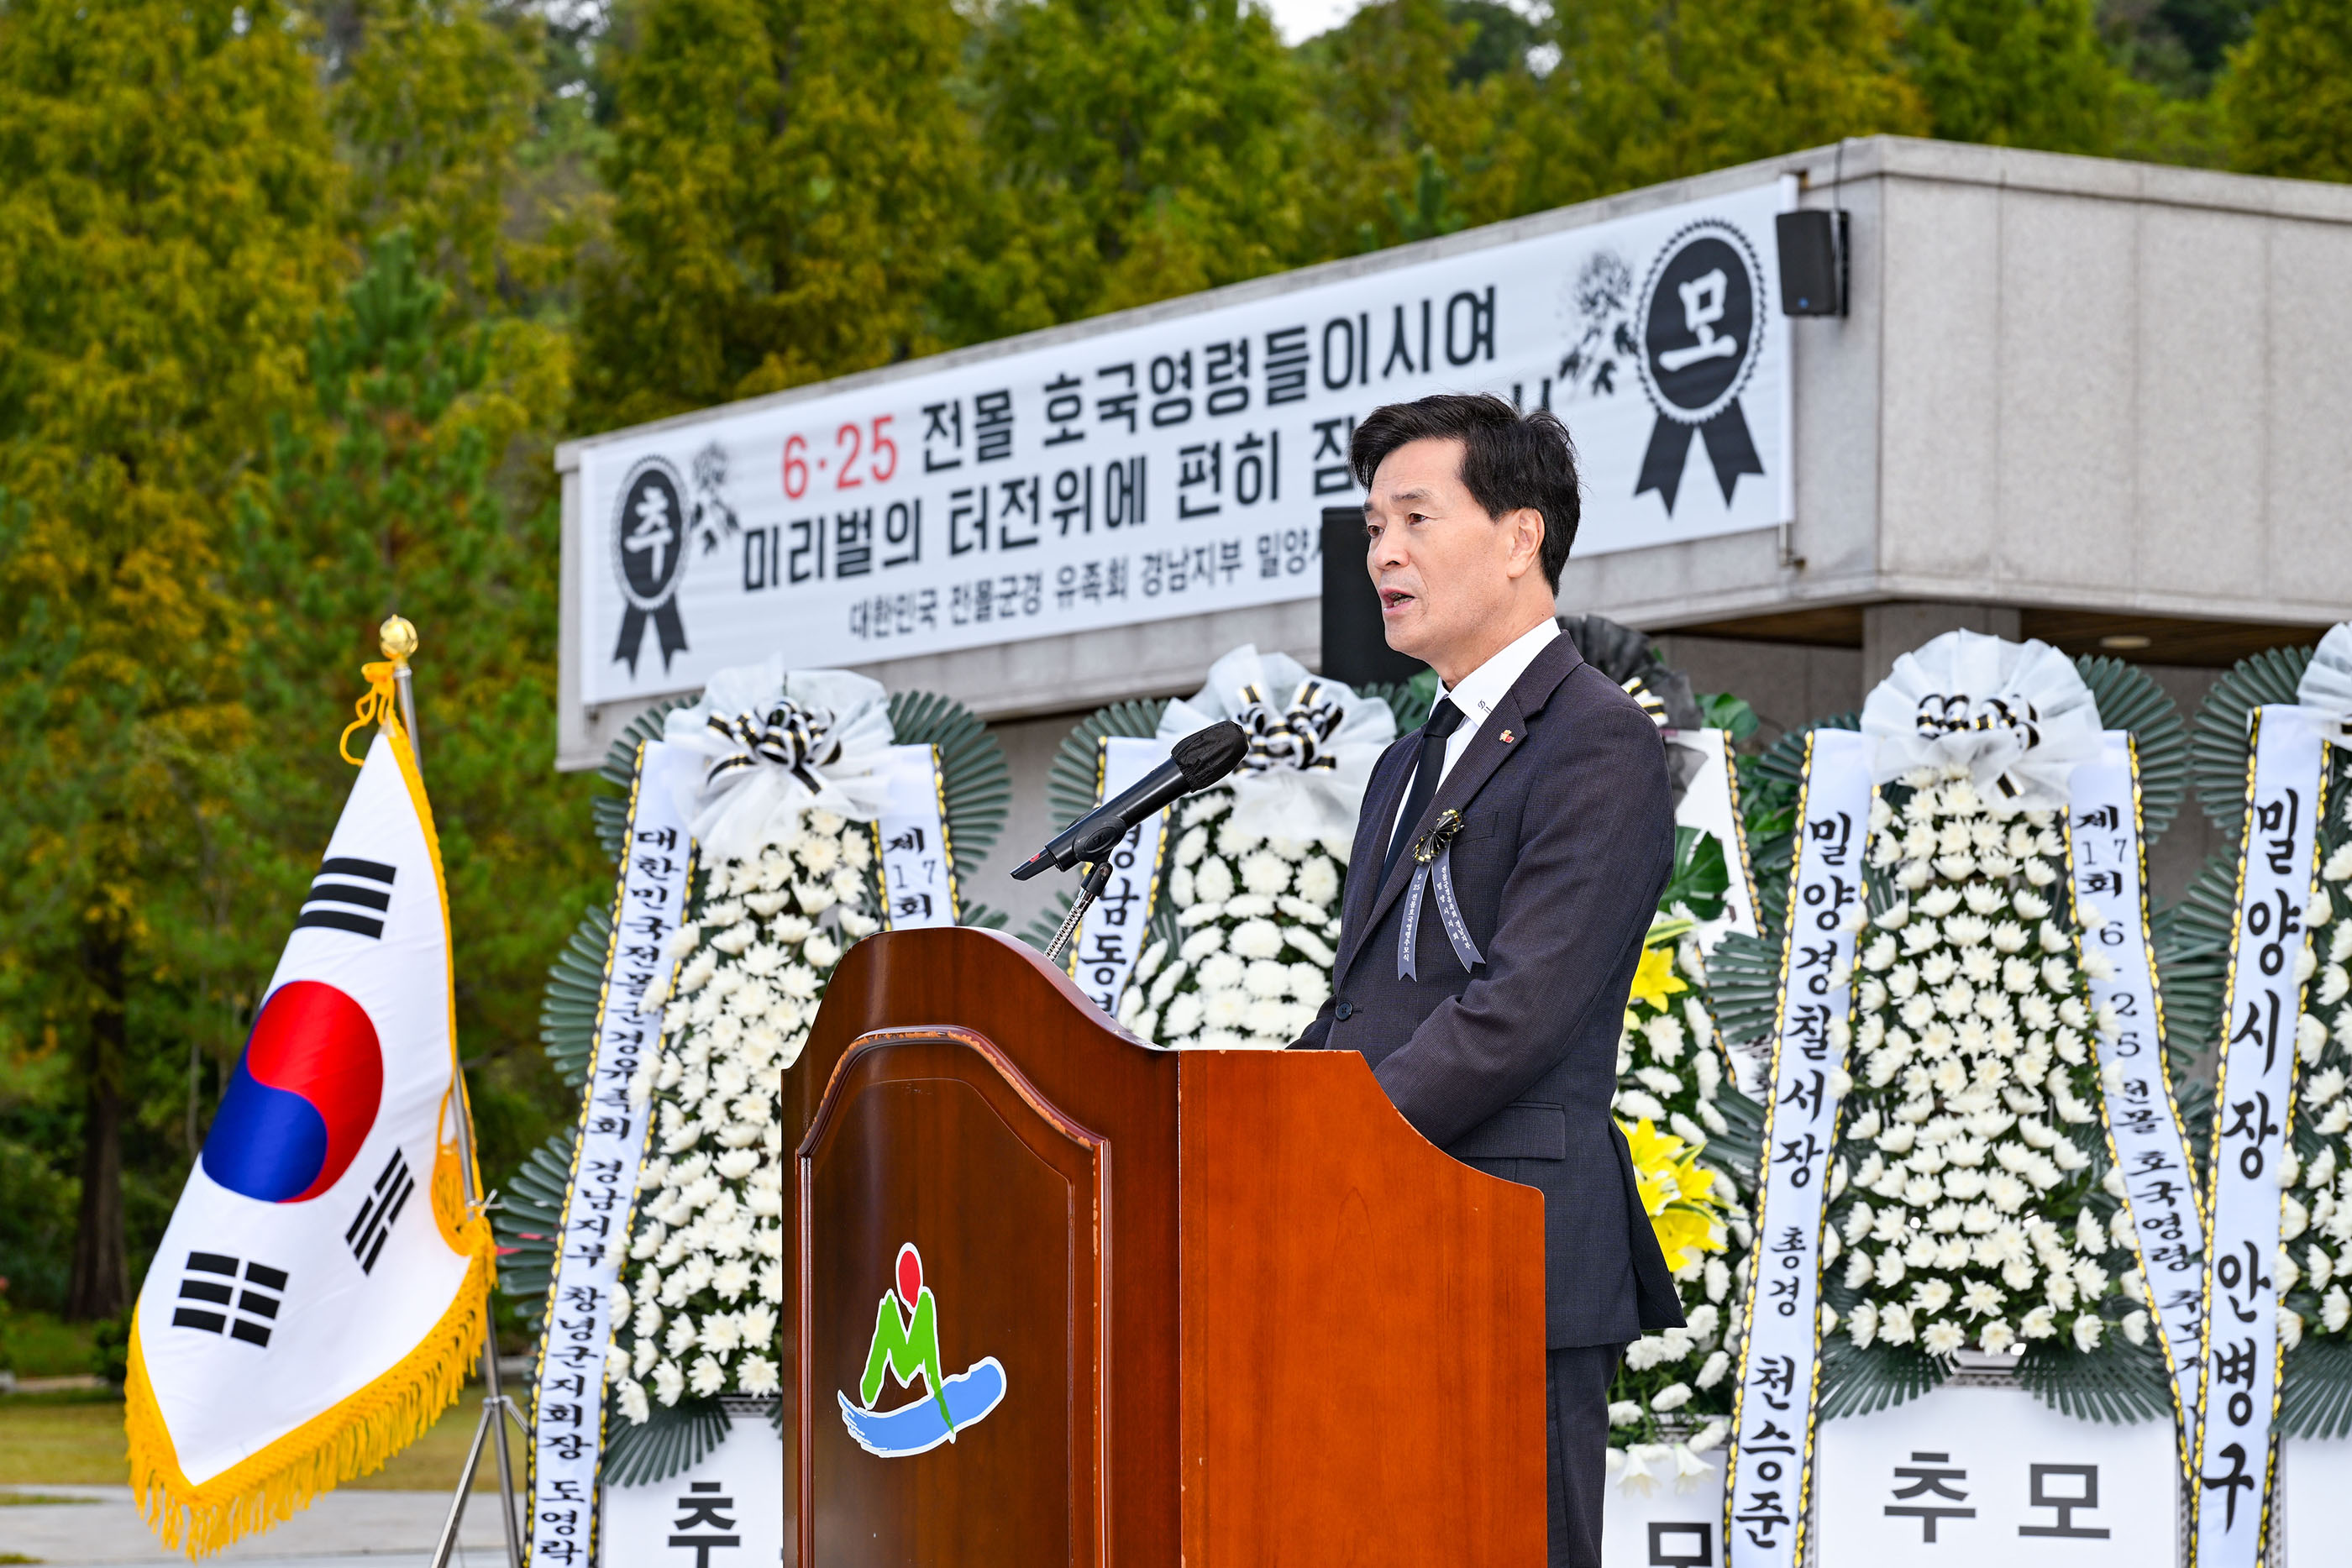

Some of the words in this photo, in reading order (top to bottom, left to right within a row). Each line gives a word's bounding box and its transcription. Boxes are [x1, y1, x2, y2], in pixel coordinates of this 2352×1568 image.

[921, 388, 1013, 474] 전몰
[1043, 285, 1498, 448] 호국영령들이시여
[1658, 268, 1737, 372] 모
[625, 485, 673, 585] 추
[744, 498, 921, 593] 미리벌의
[951, 453, 1147, 558] 터전위에
[1178, 428, 1279, 522] 편히
[849, 589, 938, 640] 대한민국
[950, 570, 1043, 627] 전몰군경
[1056, 556, 1129, 611] 유족회
[1141, 538, 1242, 599] 경남지부
[1258, 527, 1323, 580] 밀양
[1772, 810, 1855, 1189] 밀양경찰서장
[2223, 788, 2301, 1180] 밀양시장
[1768, 1225, 1807, 1317] 총경
[1735, 1354, 1797, 1550] 천승준
[2202, 1240, 2271, 1534] 안병구
